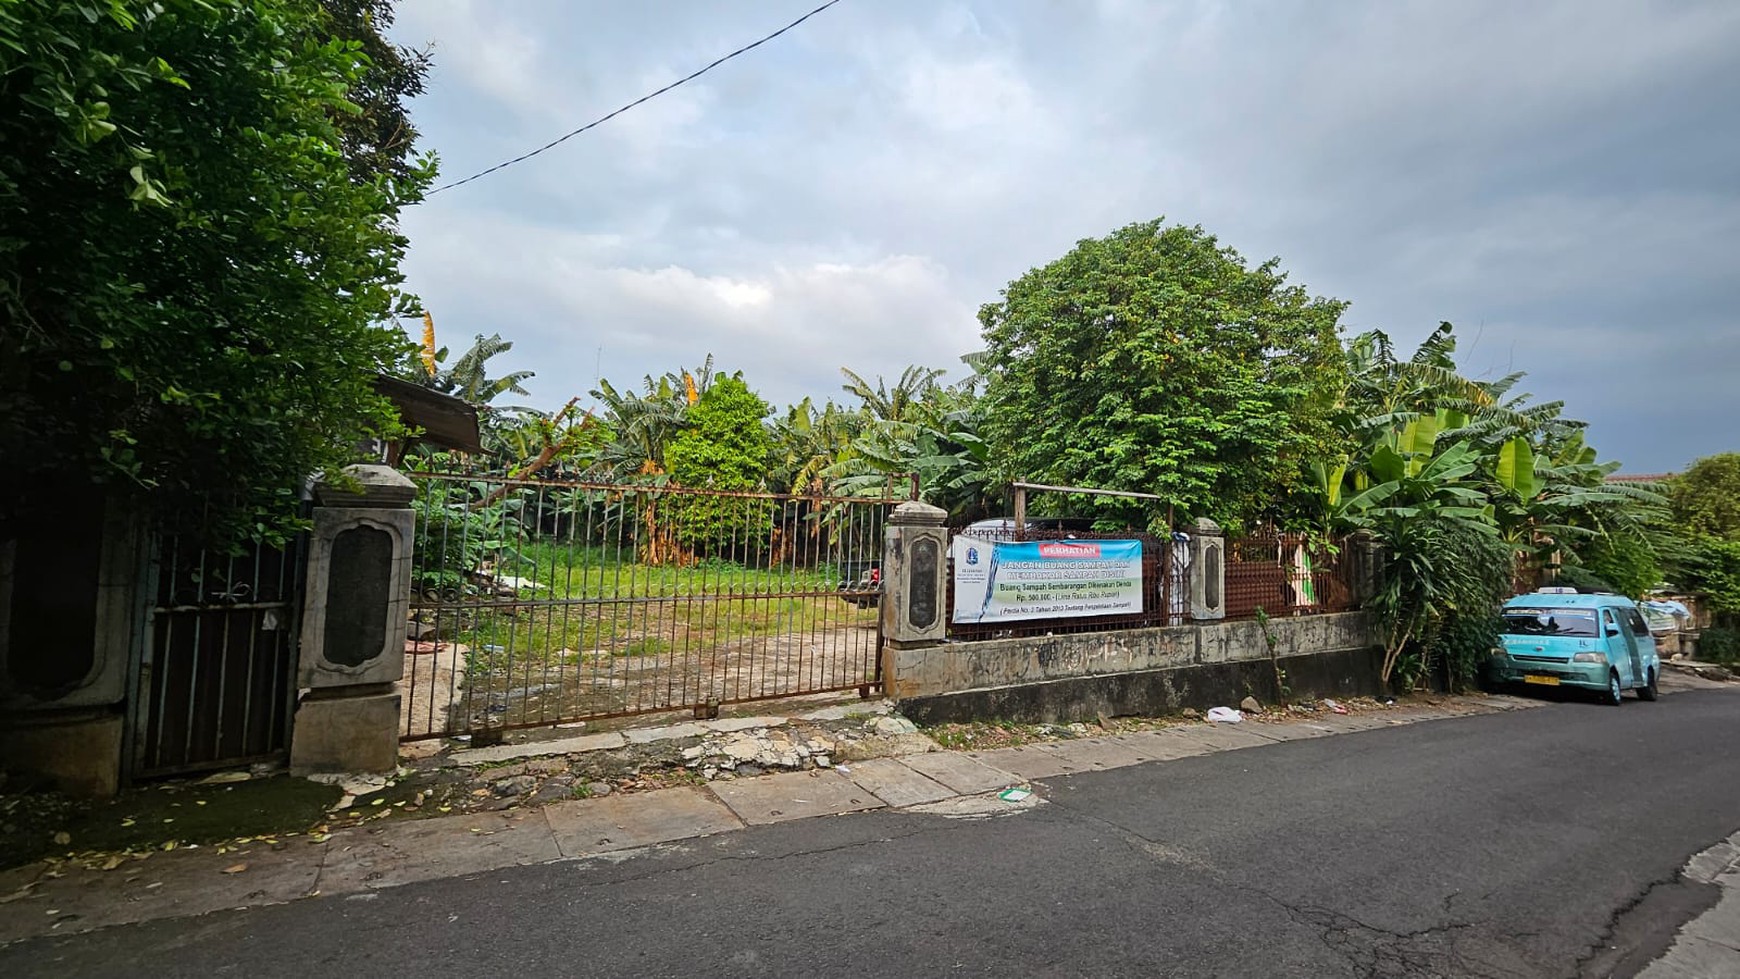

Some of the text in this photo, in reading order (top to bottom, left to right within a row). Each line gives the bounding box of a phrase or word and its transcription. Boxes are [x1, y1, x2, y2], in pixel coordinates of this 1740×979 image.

[1043, 546, 1096, 555] PERHATIAN
[1002, 561, 1042, 570] JANGAN
[1044, 561, 1075, 570] BUANG
[1000, 580, 1132, 592] Buang Sampah Sembarangan Dikenakan Denda
